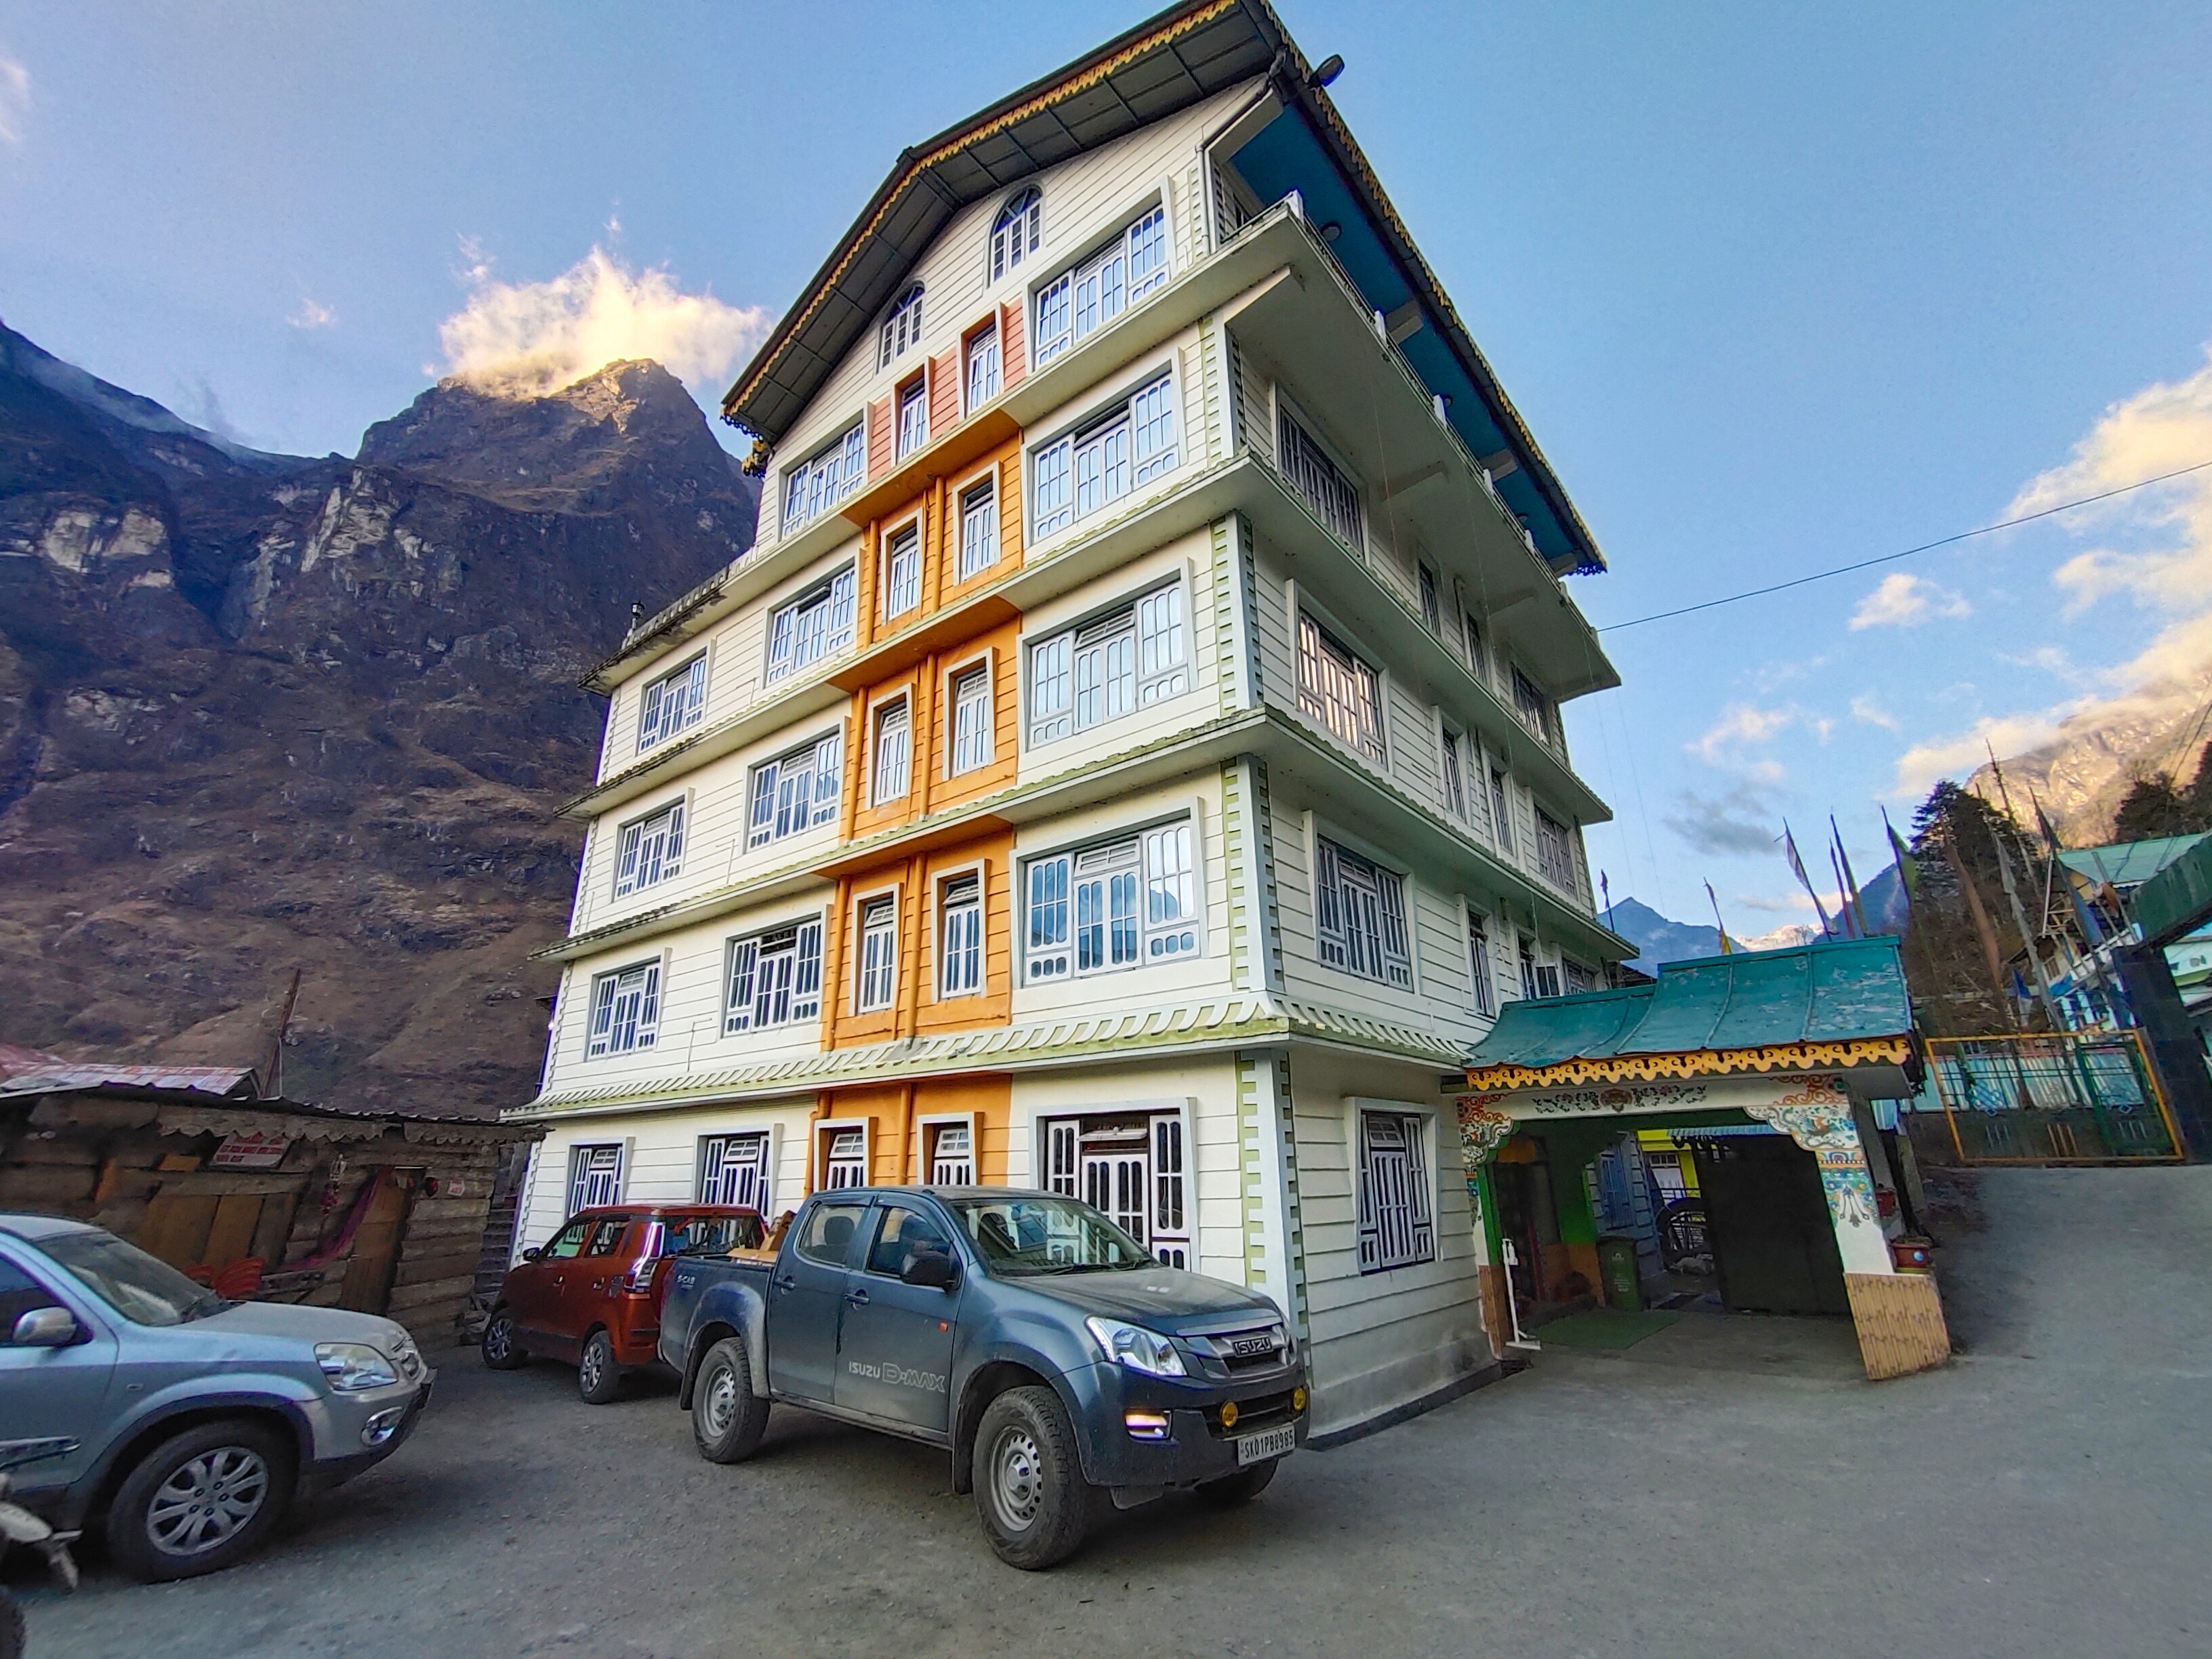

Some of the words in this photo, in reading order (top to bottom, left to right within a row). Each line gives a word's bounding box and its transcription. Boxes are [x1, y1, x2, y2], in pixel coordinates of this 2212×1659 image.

[1234, 1337, 1271, 1355] ISUZU
[848, 1361, 880, 1379] ISUZU
[1244, 1429, 1294, 1459] SK01PB8985
